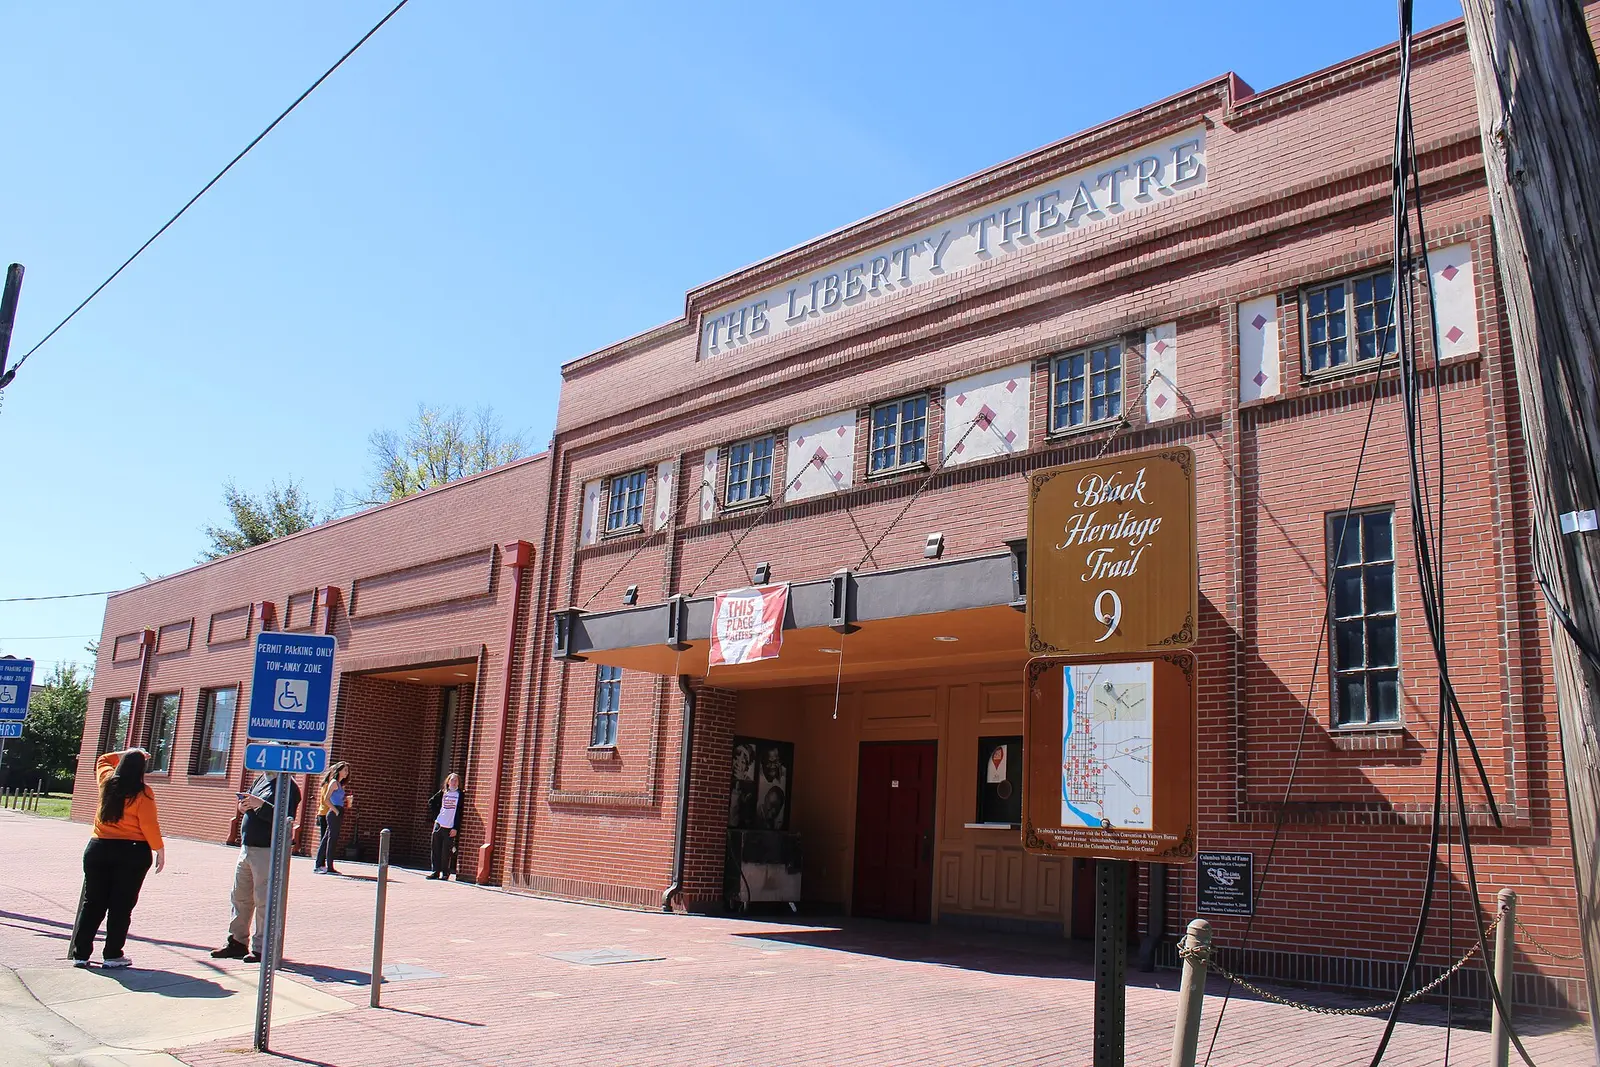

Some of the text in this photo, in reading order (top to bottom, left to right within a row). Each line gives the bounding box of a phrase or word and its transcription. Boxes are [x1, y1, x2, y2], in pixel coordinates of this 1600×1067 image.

[704, 138, 1202, 350] THE LIBERTY THEATRE
[1073, 467, 1153, 508] Black
[1055, 509, 1162, 550] Heritage
[1080, 543, 1152, 582] Trail
[728, 599, 755, 618] THIS
[1094, 589, 1122, 643] 9
[726, 616, 753, 632] PLACE
[258, 643, 334, 658] PERMIT PARKING ONLY
[266, 661, 322, 674] TOW-AWAY ZONE
[251, 718, 326, 731] MAXIMUM FINE $500.00
[256, 748, 316, 770] 4 HRS
